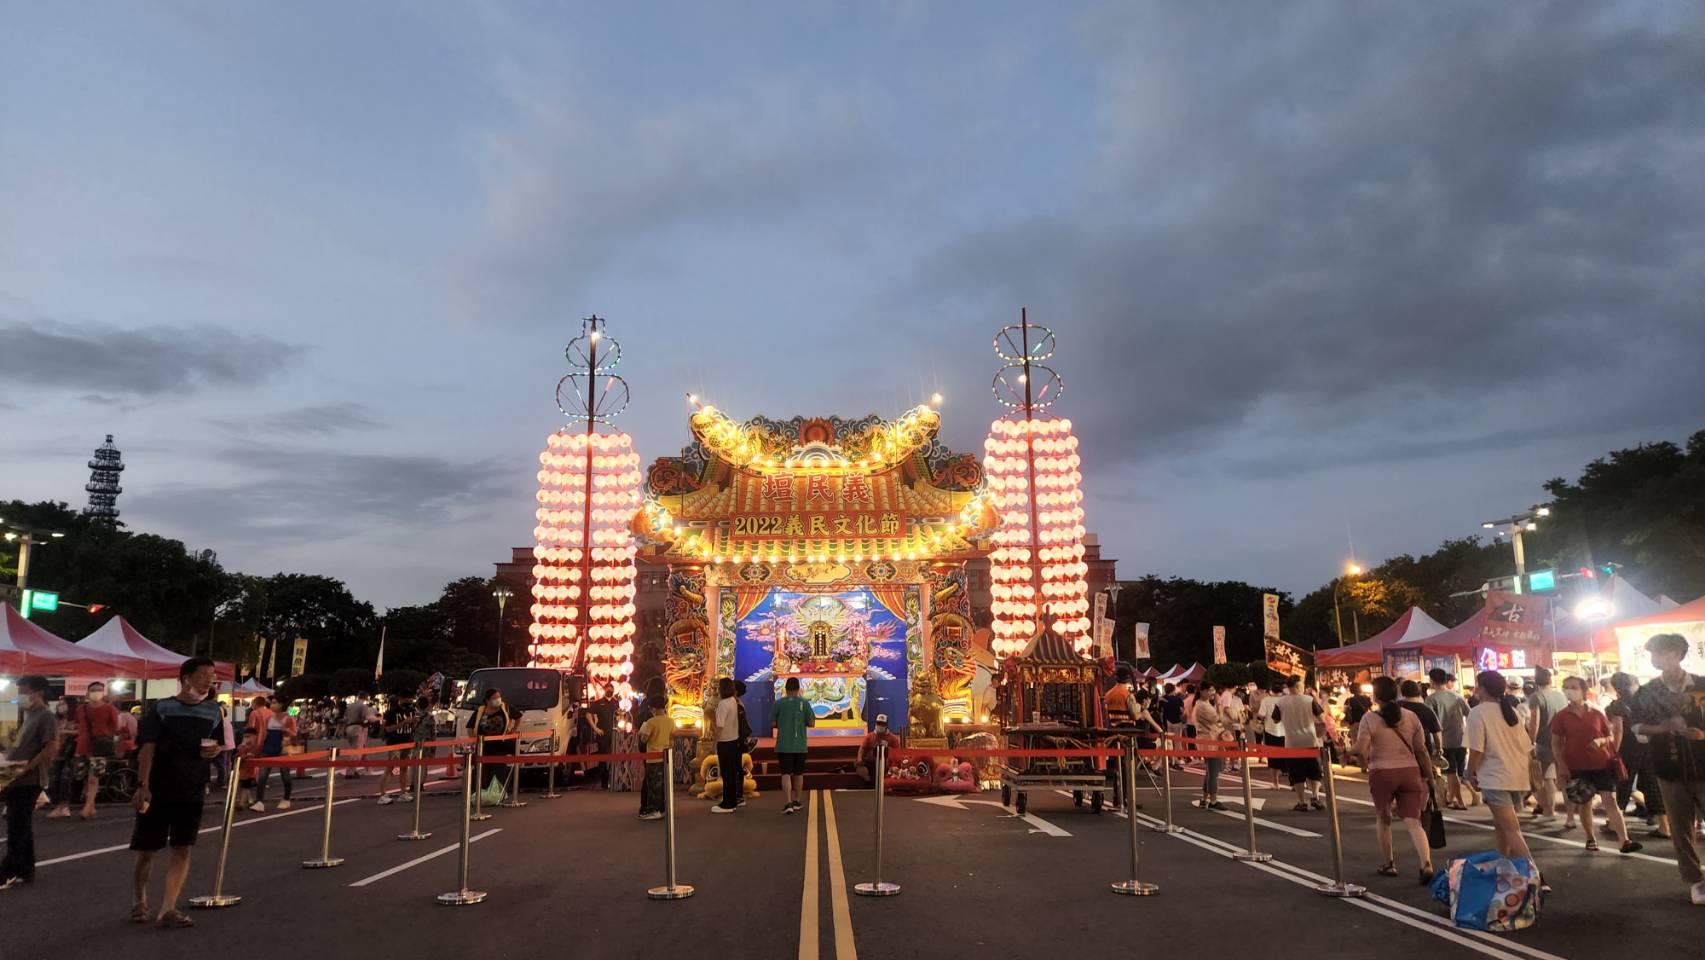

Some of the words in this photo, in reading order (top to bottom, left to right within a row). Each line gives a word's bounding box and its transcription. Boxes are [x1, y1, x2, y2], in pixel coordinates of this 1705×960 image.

[734, 513, 900, 537] 2022義民文化節
